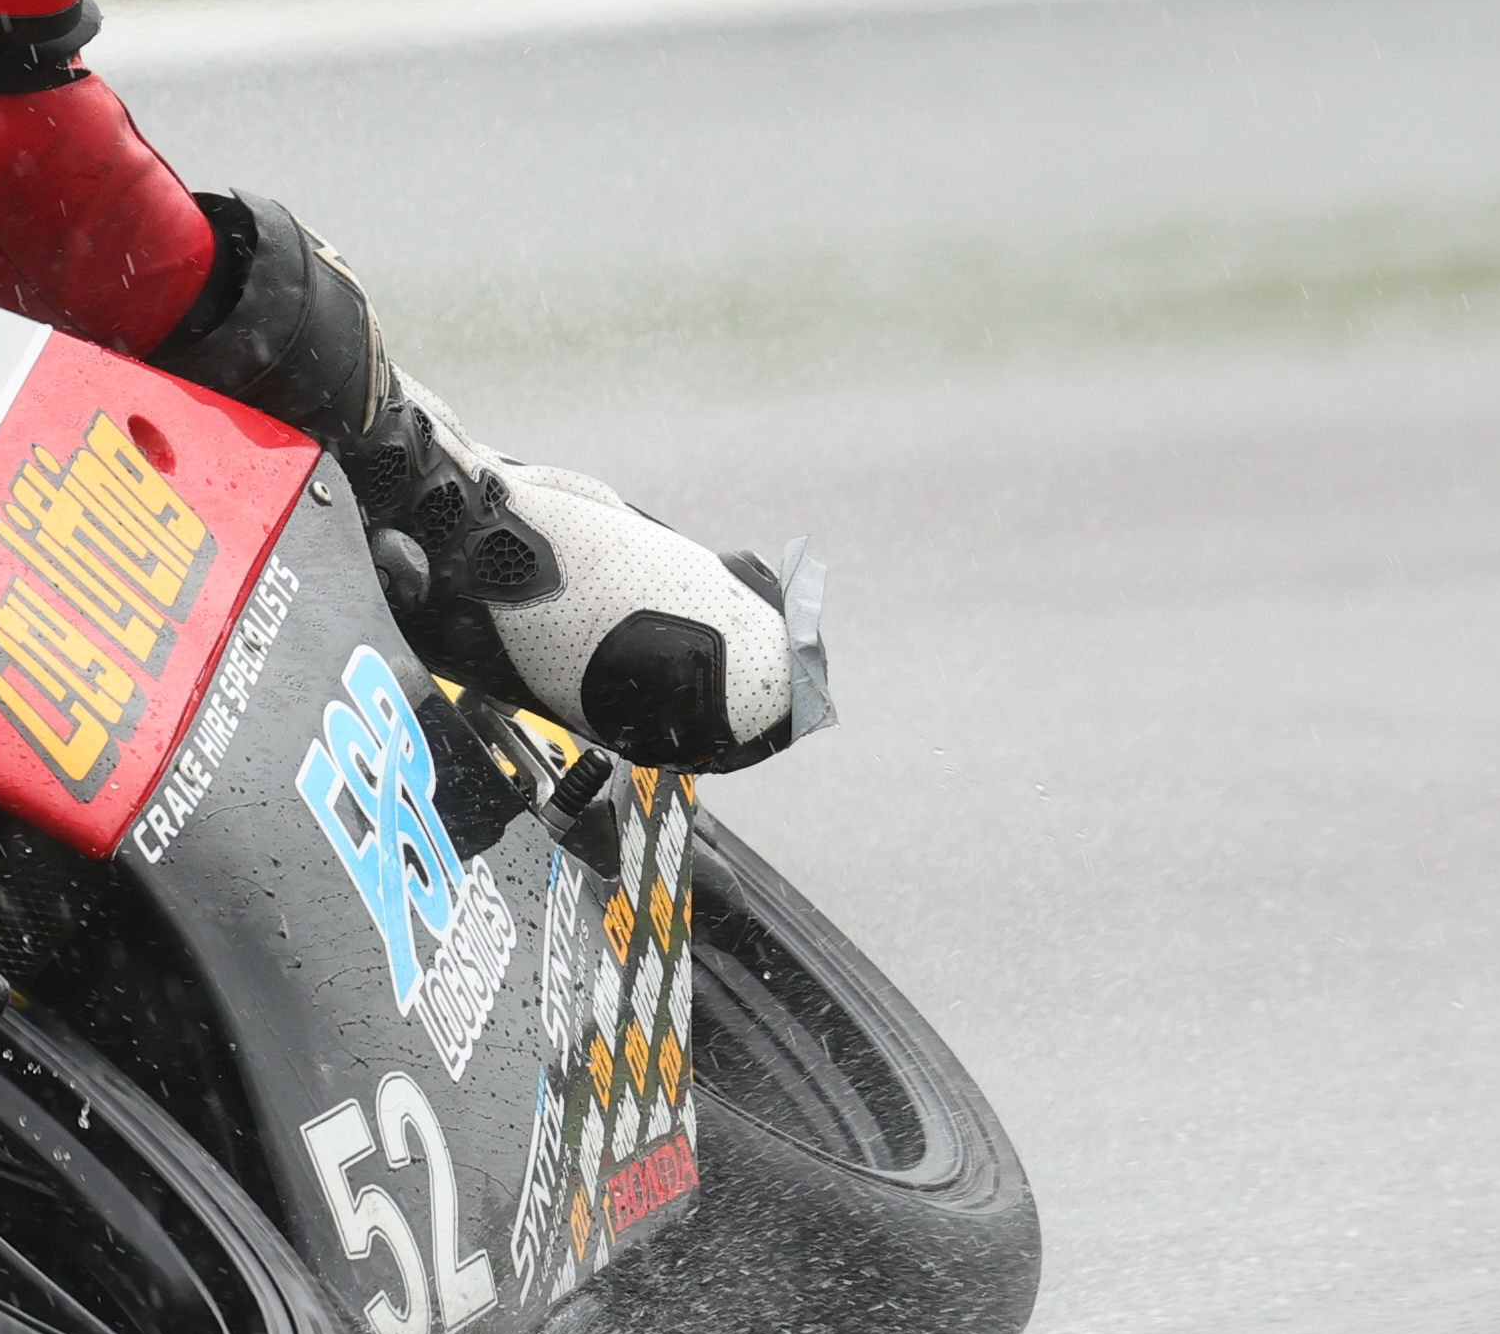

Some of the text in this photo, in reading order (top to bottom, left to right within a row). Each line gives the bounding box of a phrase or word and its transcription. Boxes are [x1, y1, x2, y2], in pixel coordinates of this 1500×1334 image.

[132, 554, 300, 865] CRANE HIRE SPECIALISTS
[413, 854, 518, 1084] LOGISTICS
[541, 853, 583, 1077] SYNTOL
[511, 1078, 565, 1308] SYNTOL
[609, 1135, 700, 1233] HONDA
